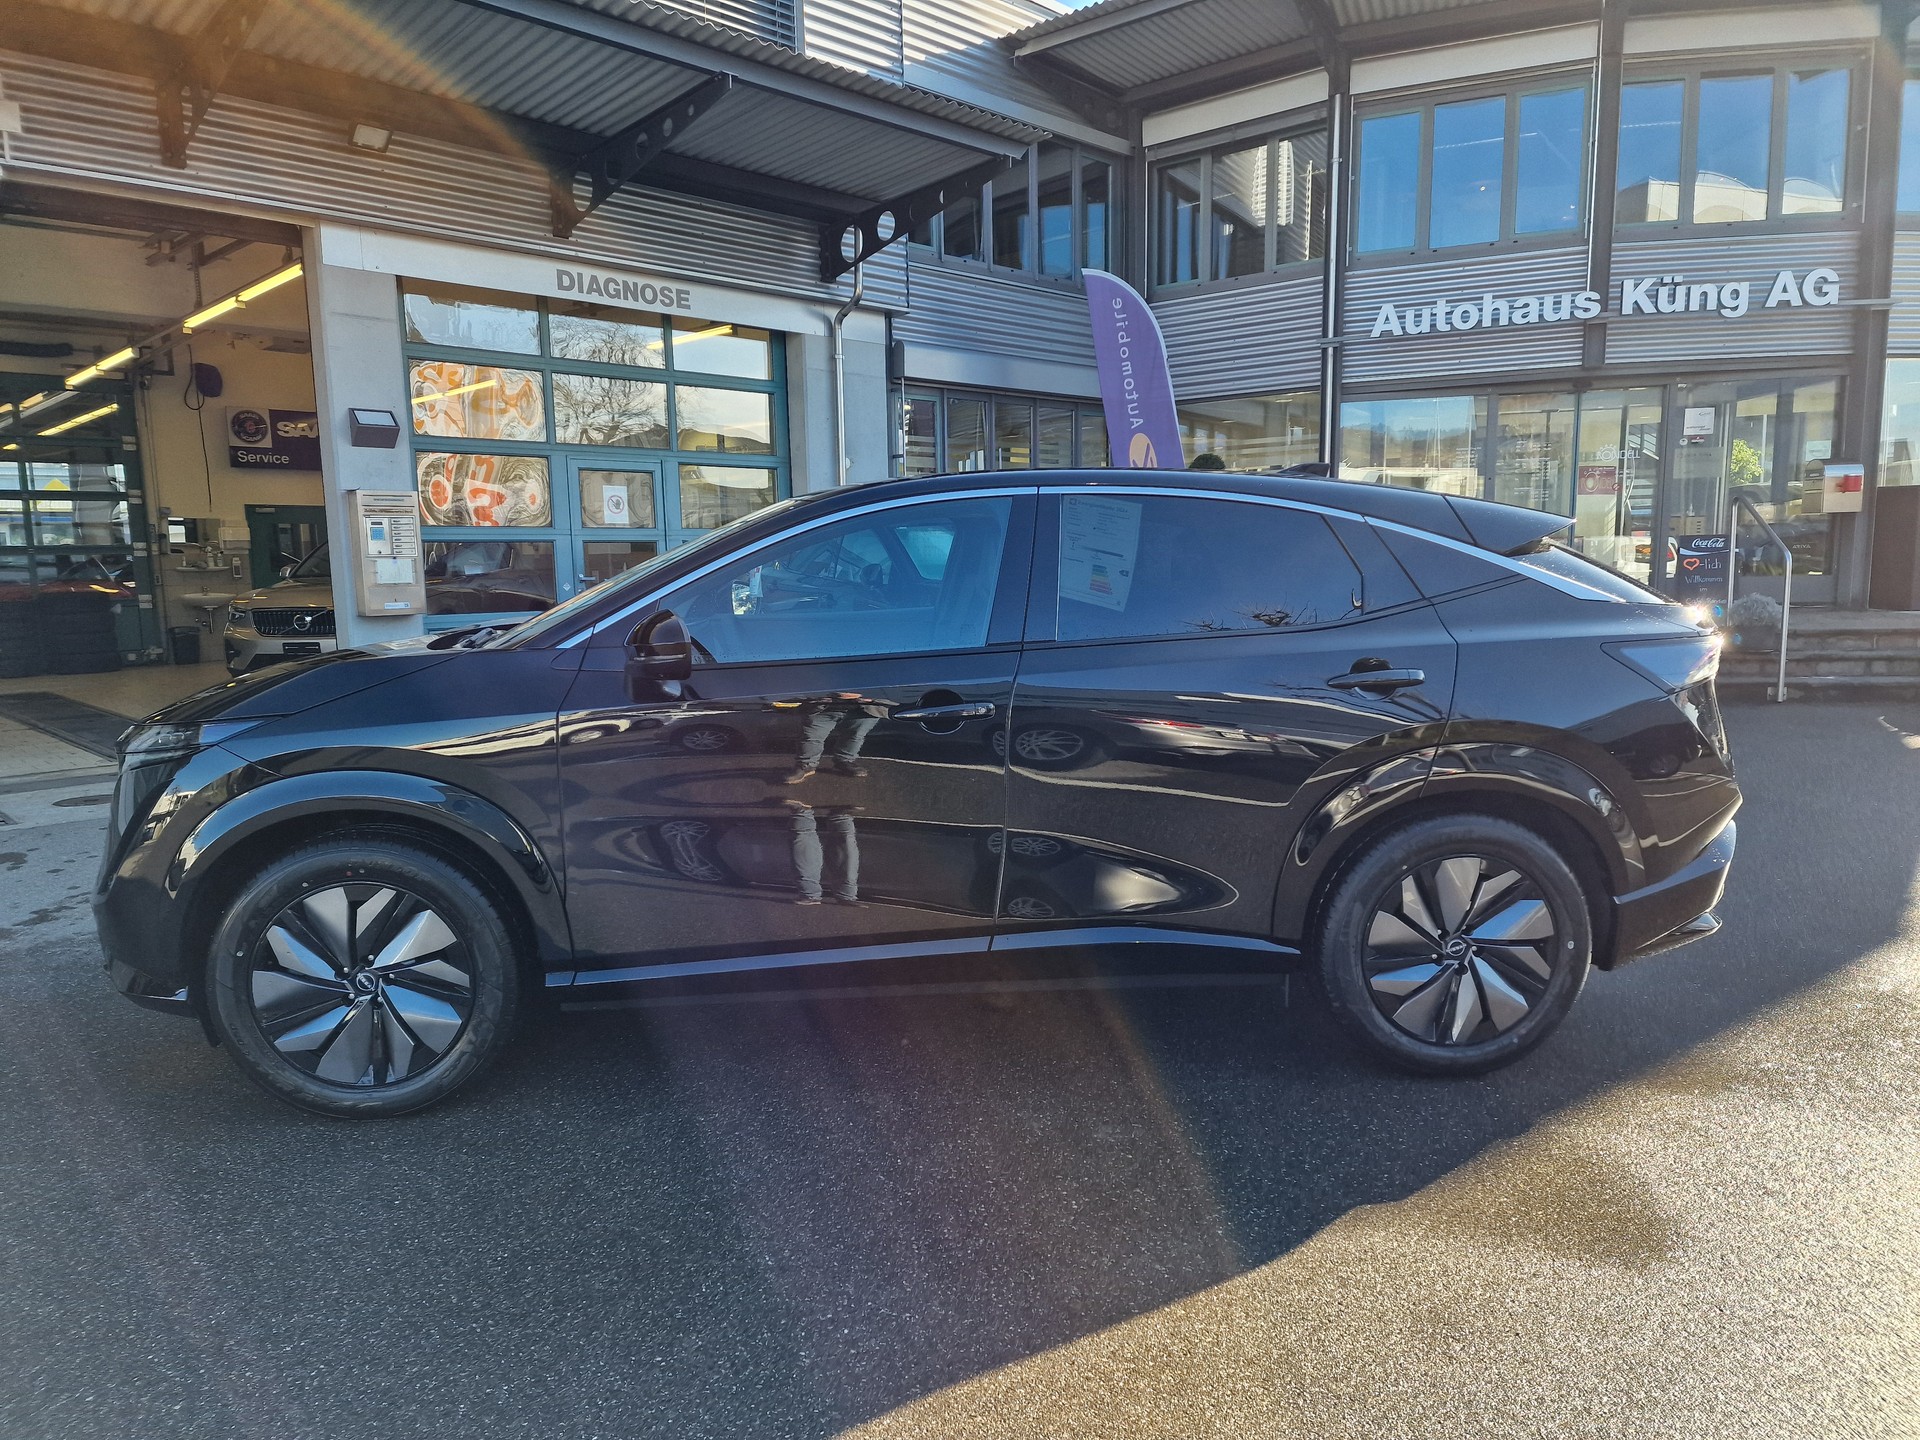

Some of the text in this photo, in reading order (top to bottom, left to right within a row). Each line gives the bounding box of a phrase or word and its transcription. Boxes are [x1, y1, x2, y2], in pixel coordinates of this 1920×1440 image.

[556, 268, 691, 310] DIAGNOSE
[1370, 268, 1840, 337] Autohaus Küng AG
[237, 450, 290, 464] Service
